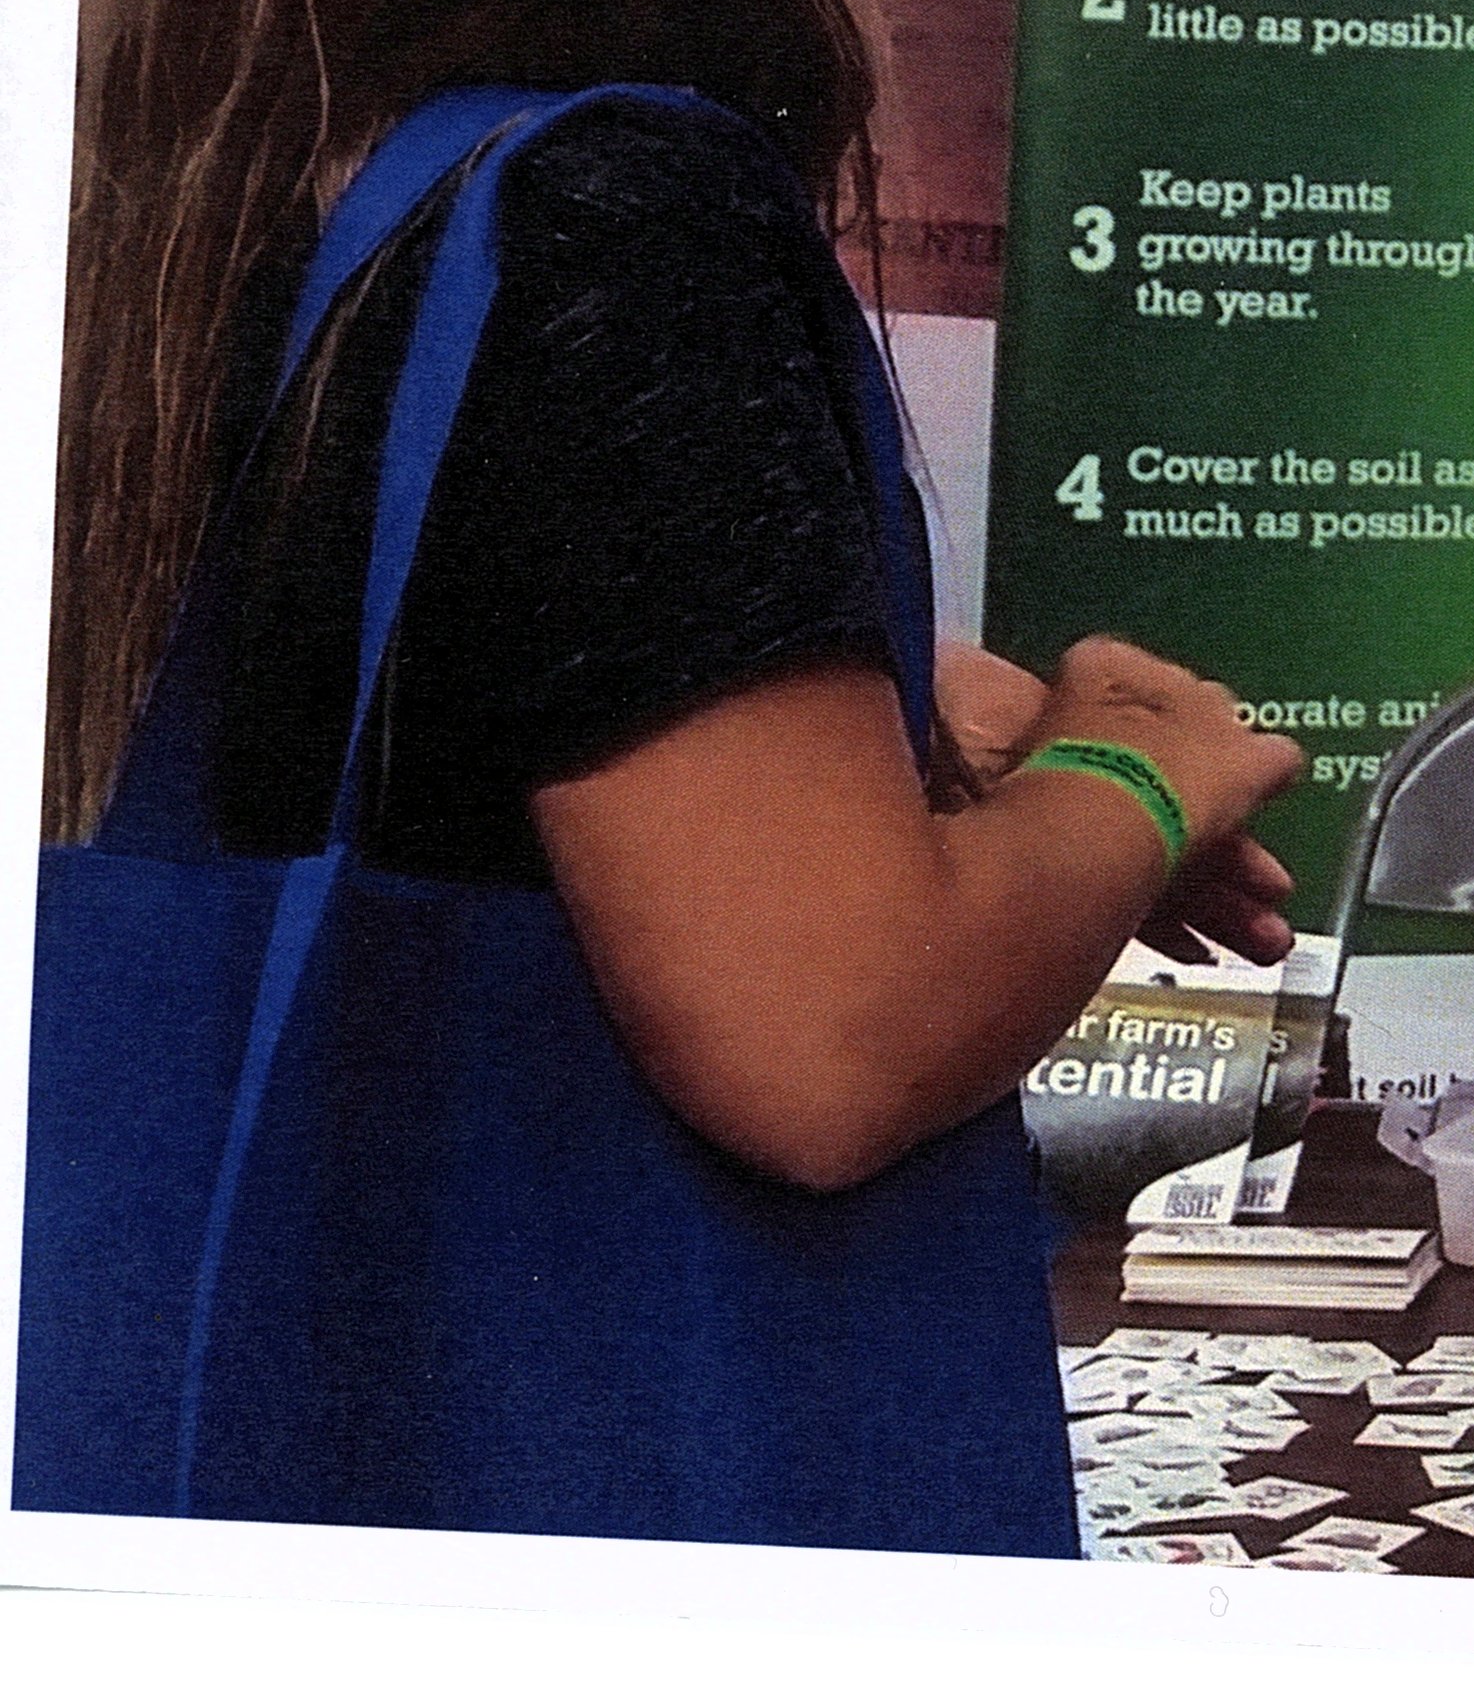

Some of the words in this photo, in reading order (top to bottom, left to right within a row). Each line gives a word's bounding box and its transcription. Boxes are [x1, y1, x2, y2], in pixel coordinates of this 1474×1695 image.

[1149, 4, 1243, 41] little
[1257, 17, 1301, 43] as
[1141, 170, 1251, 217] Keep
[1262, 175, 1390, 219] plants
[1071, 207, 1114, 271] 3
[1138, 235, 1315, 274] growing
[1137, 280, 1203, 316] the
[1215, 291, 1316, 325] year.
[1128, 447, 1258, 483] Cover
[1271, 450, 1336, 484] the
[1349, 452, 1422, 485] soil
[1057, 455, 1103, 519] 4
[1125, 503, 1243, 538] much
[1255, 512, 1300, 538] as
[1313, 751, 1392, 791] sys
[1108, 1009, 1236, 1051] farm's
